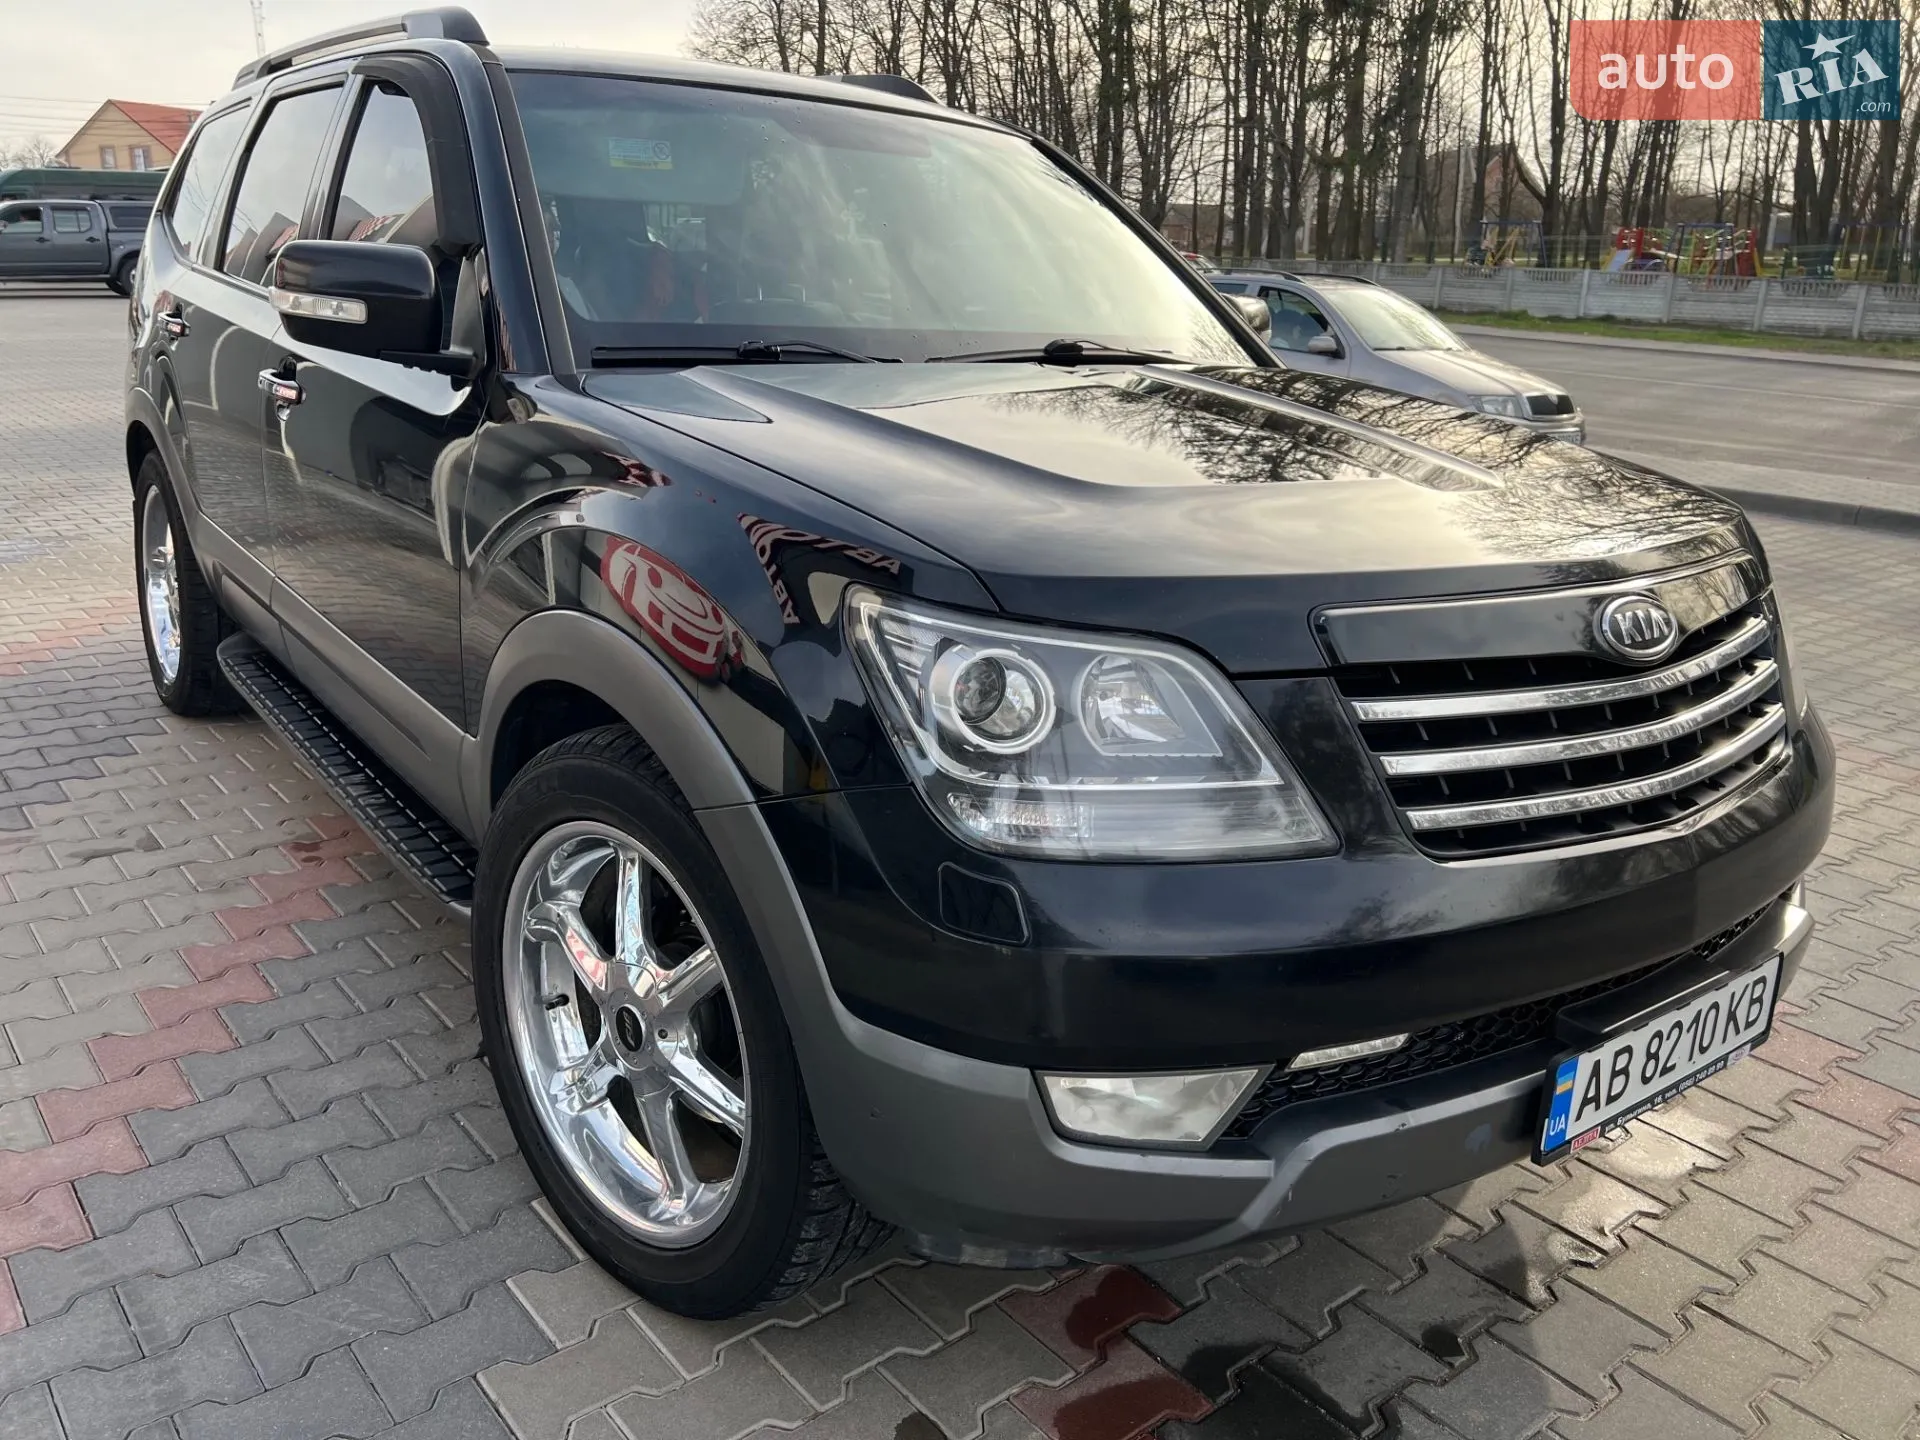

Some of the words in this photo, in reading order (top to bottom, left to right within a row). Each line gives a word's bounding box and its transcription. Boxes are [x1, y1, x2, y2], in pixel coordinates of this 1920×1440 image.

[1613, 607, 1669, 645] KIA
[1574, 1043, 1633, 1123] AB
[1640, 1001, 1720, 1086] 8210
[1722, 975, 1768, 1044] KB
[1549, 1113, 1566, 1137] UA
